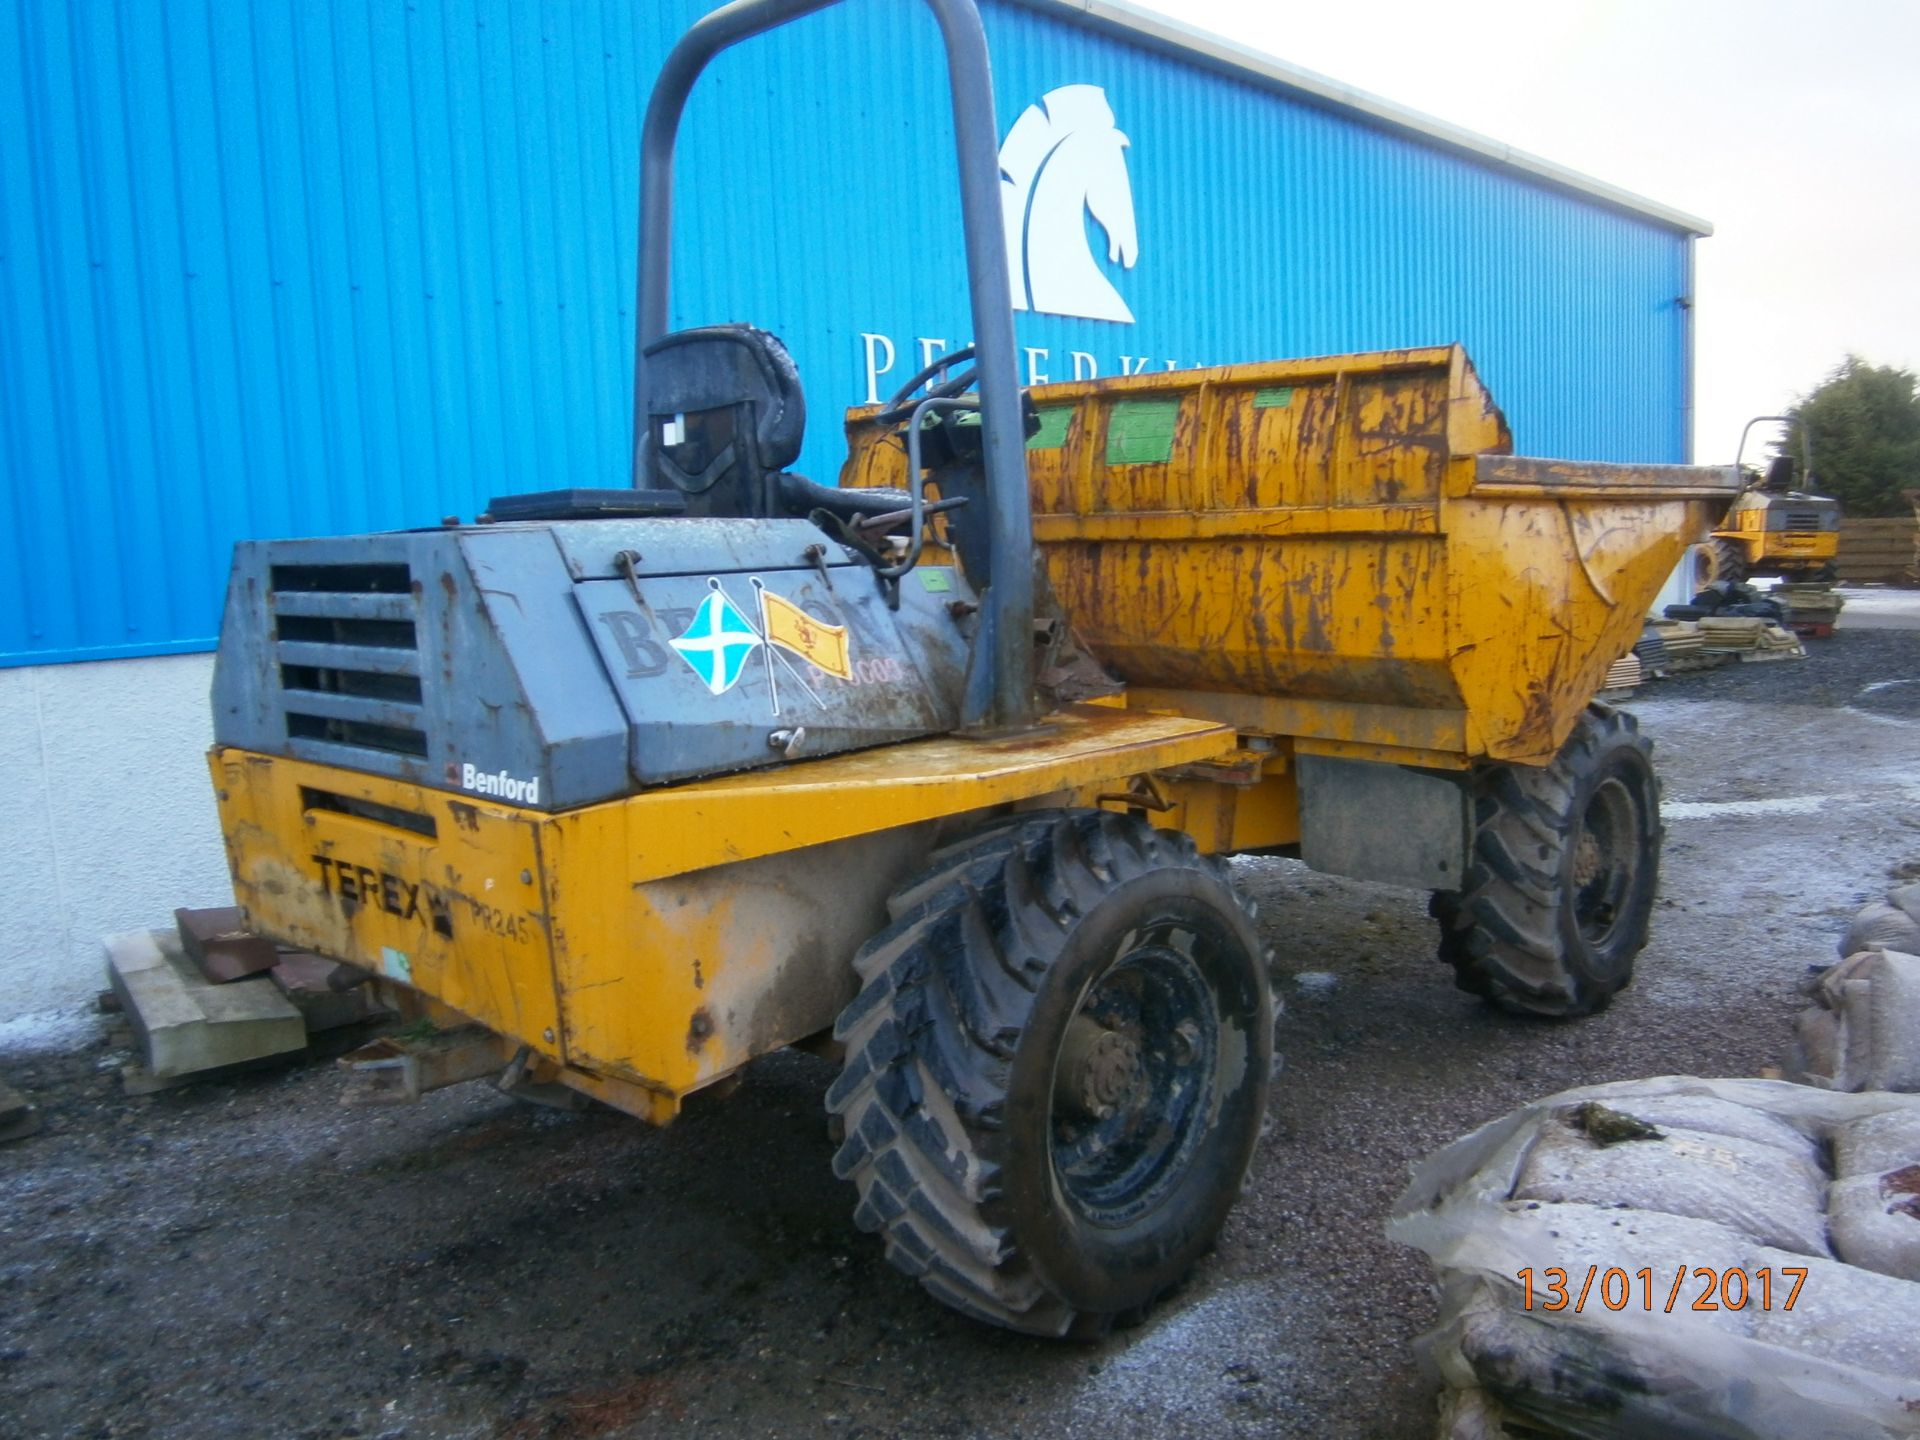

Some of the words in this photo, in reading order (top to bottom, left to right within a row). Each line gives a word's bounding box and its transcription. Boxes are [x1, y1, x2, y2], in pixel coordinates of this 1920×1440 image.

[462, 763, 539, 804] Benford
[311, 855, 427, 928] TEREX
[471, 902, 529, 945] PR245
